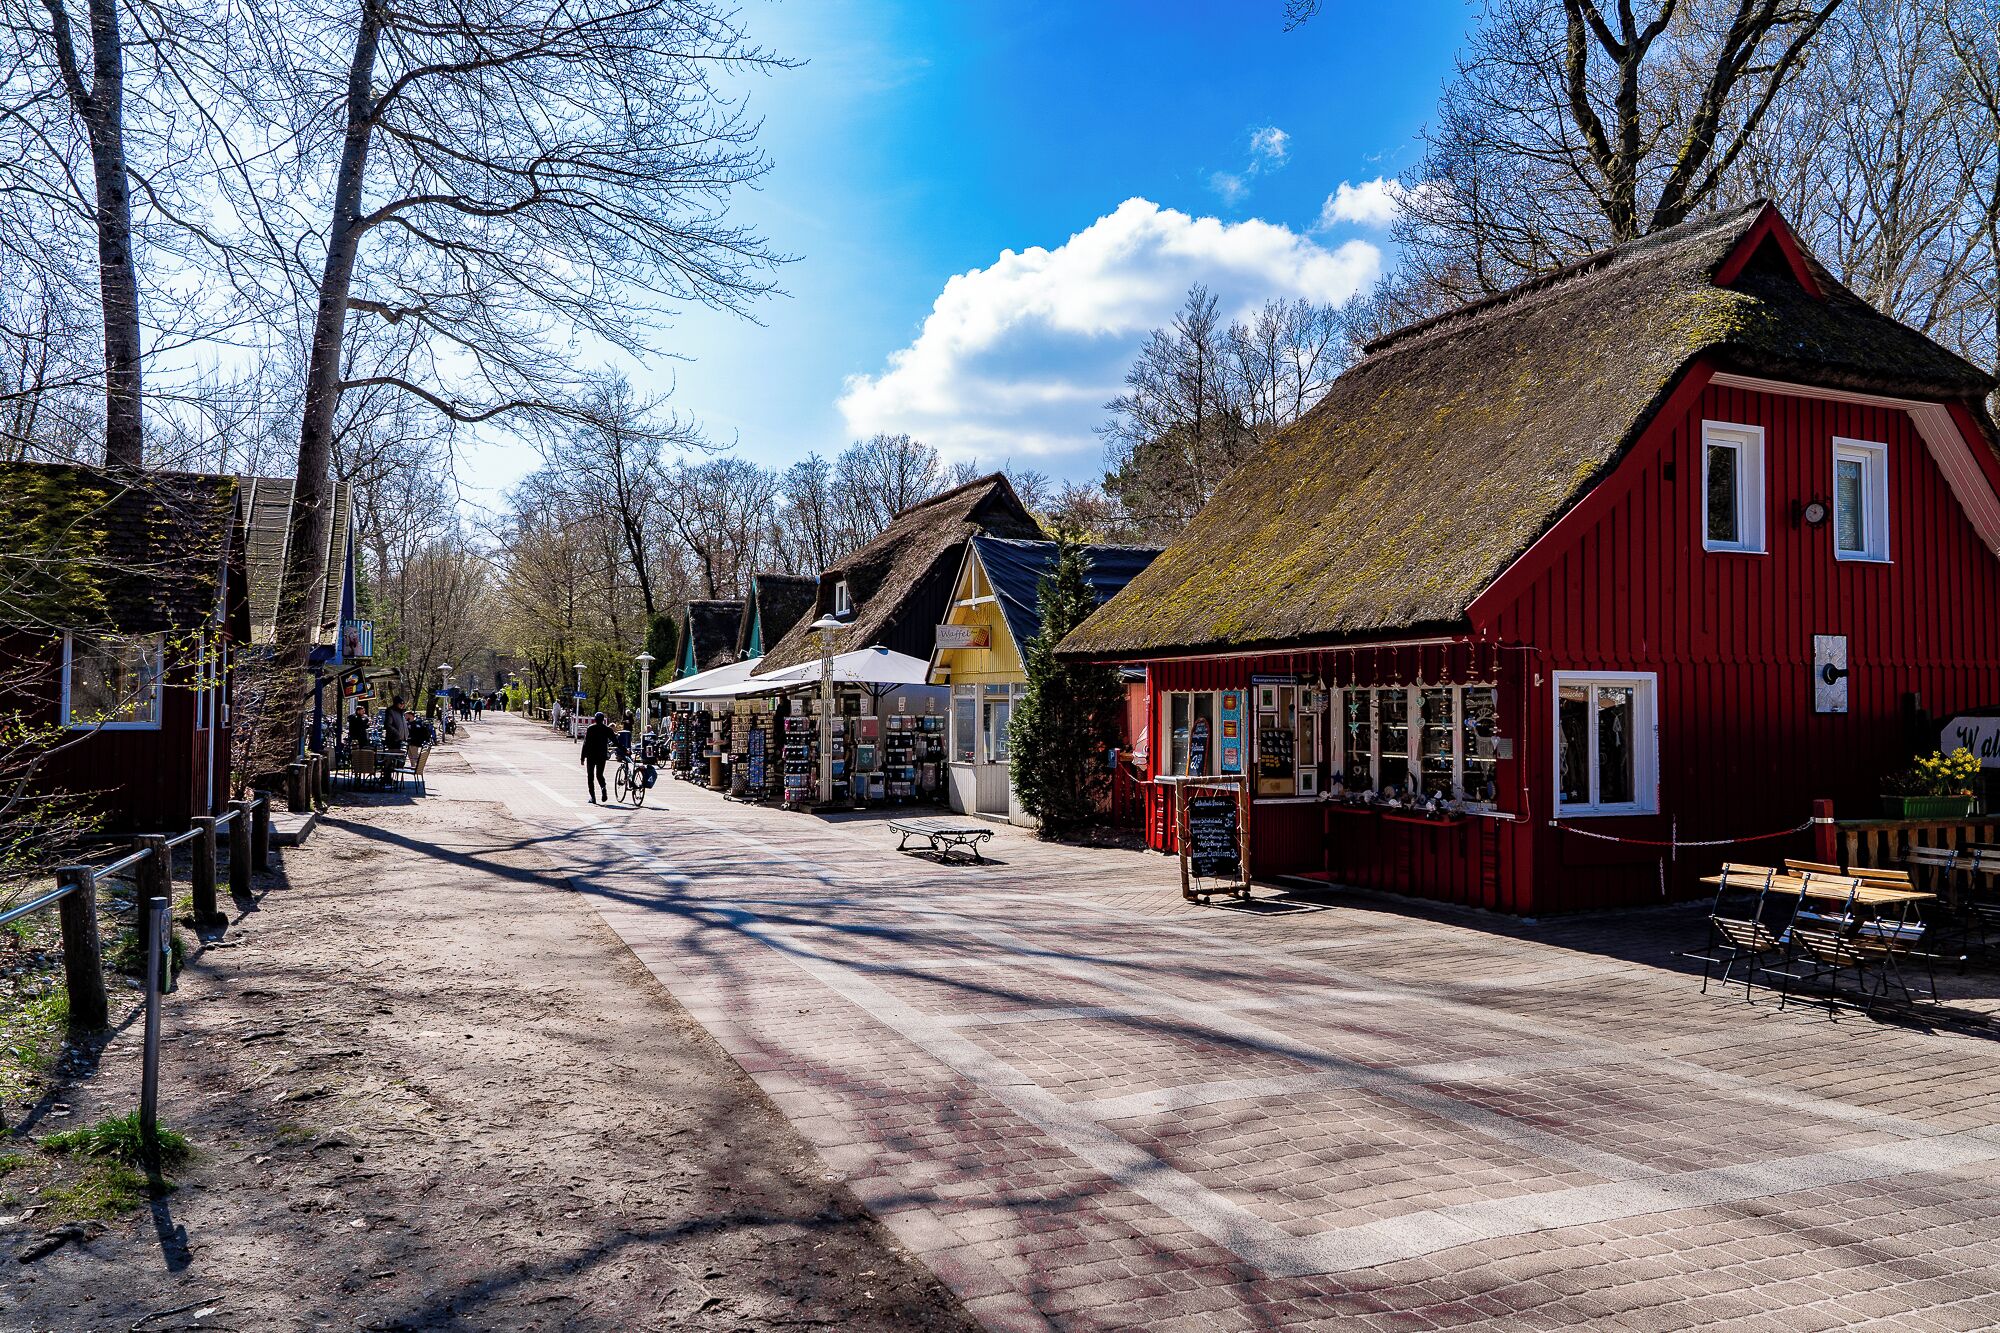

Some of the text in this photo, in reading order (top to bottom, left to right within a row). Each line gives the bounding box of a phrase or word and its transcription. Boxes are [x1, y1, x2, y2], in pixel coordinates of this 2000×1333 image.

[940, 629, 971, 640] Waffel
[344, 682, 364, 696] EIS
[1956, 725, 2000, 757] Wal
[1110, 751, 1115, 760] P
